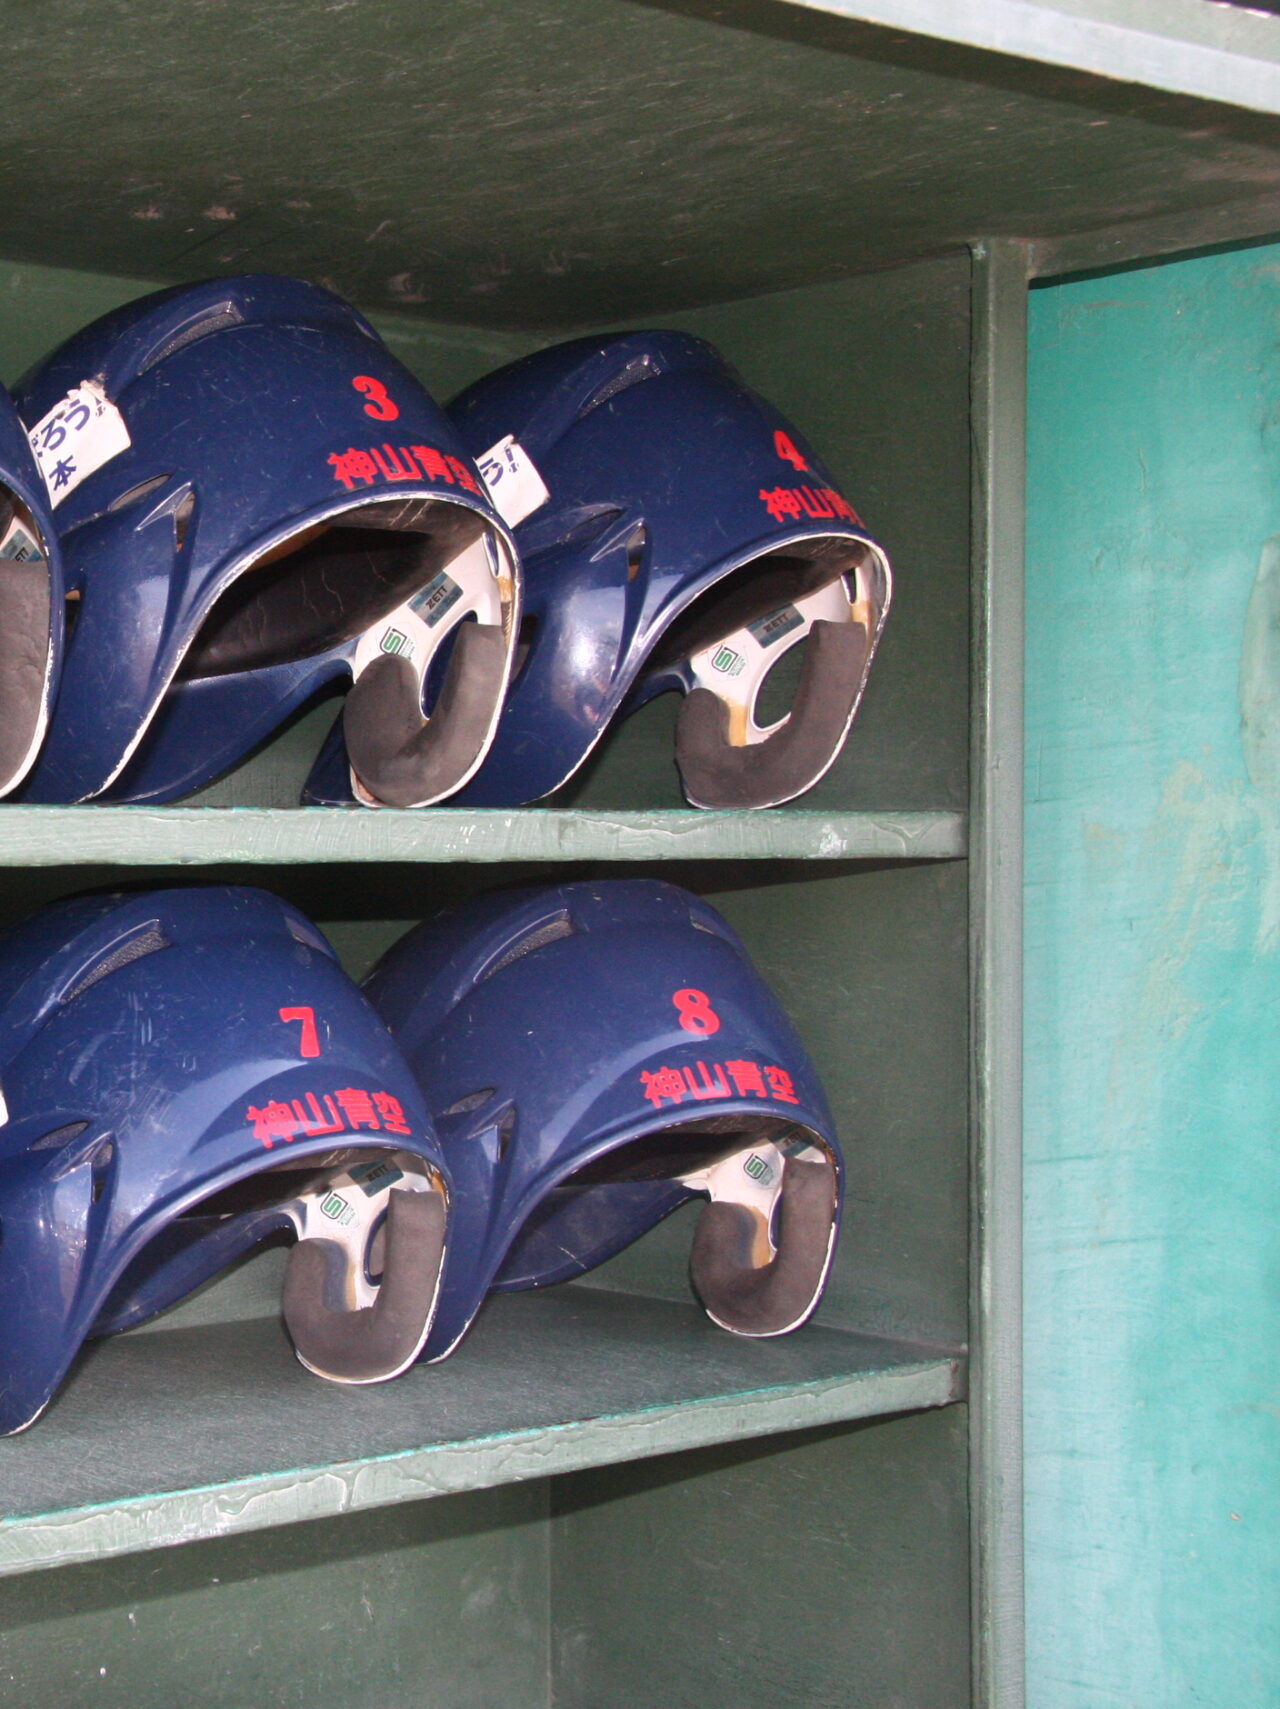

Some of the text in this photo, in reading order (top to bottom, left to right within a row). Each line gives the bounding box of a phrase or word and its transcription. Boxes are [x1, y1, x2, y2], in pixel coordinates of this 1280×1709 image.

[351, 375, 400, 422] 3
[327, 443, 482, 497] 神山青空
[773, 430, 809, 471] 4
[758, 484, 867, 529] 神山青
[424, 585, 449, 610] ZETT
[278, 1006, 321, 1058] 7
[671, 988, 721, 1036] 8
[639, 1059, 800, 1109] 神山青空
[245, 1087, 413, 1149] 神山青空
